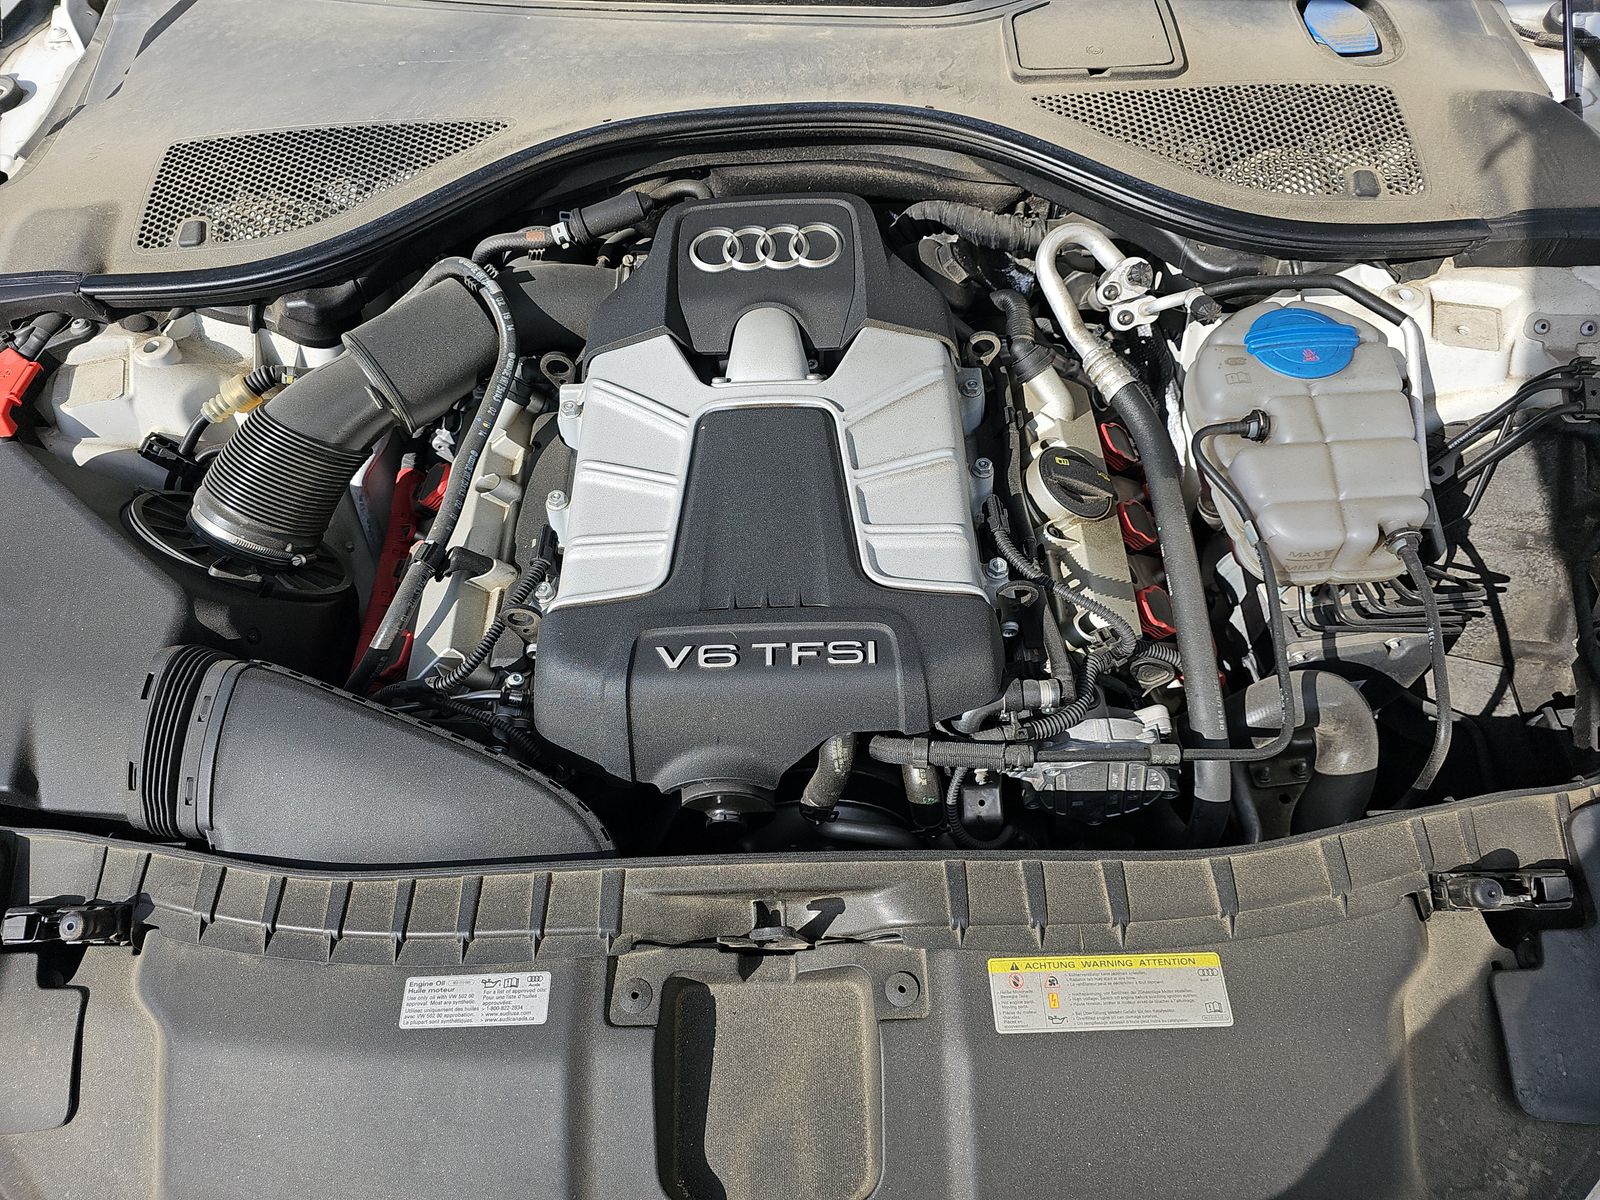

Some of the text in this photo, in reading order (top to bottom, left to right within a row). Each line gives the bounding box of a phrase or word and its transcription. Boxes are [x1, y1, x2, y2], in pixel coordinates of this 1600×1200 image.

[656, 640, 877, 669] V6 TFSI
[1025, 958, 1196, 969] ACHTUNG WARNING ATTENTION
